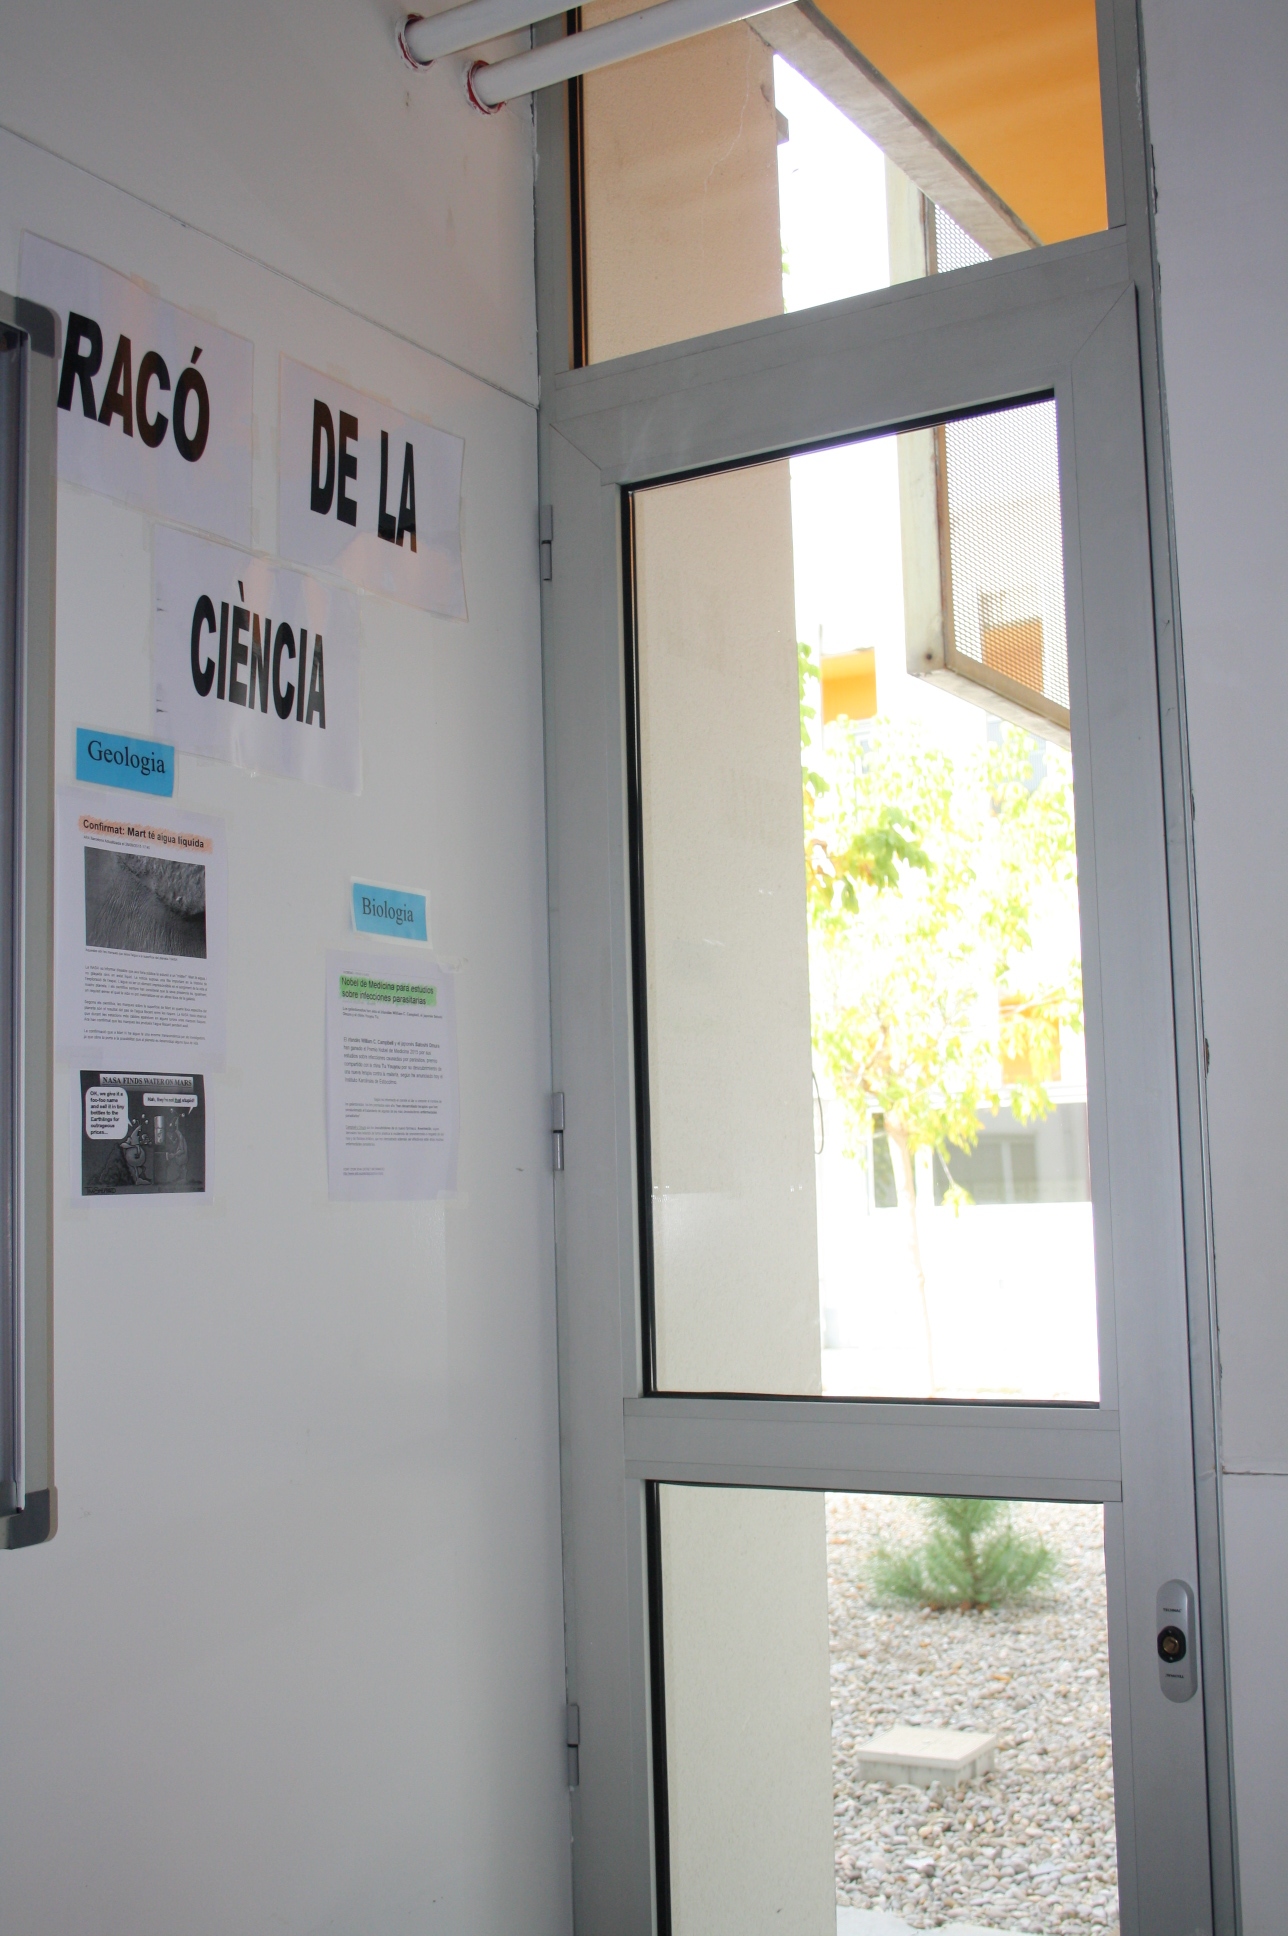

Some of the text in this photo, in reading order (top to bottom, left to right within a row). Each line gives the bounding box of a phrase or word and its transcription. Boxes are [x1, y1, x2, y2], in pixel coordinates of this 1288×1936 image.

[57, 311, 210, 463] RACÓ
[310, 398, 417, 553] DE LA
[190, 580, 326, 729] CIÈNCIA
[87, 740, 166, 775] Geologia
[83, 819, 125, 835] Confirmat:
[127, 827, 146, 838] Mart
[148, 831, 155, 840] té
[157, 832, 176, 844] aigua
[362, 897, 414, 925] Biologia
[341, 977, 434, 994] Nobel de Medicina para estudios
[342, 990, 426, 1005] sobre infecciones parasitarias
